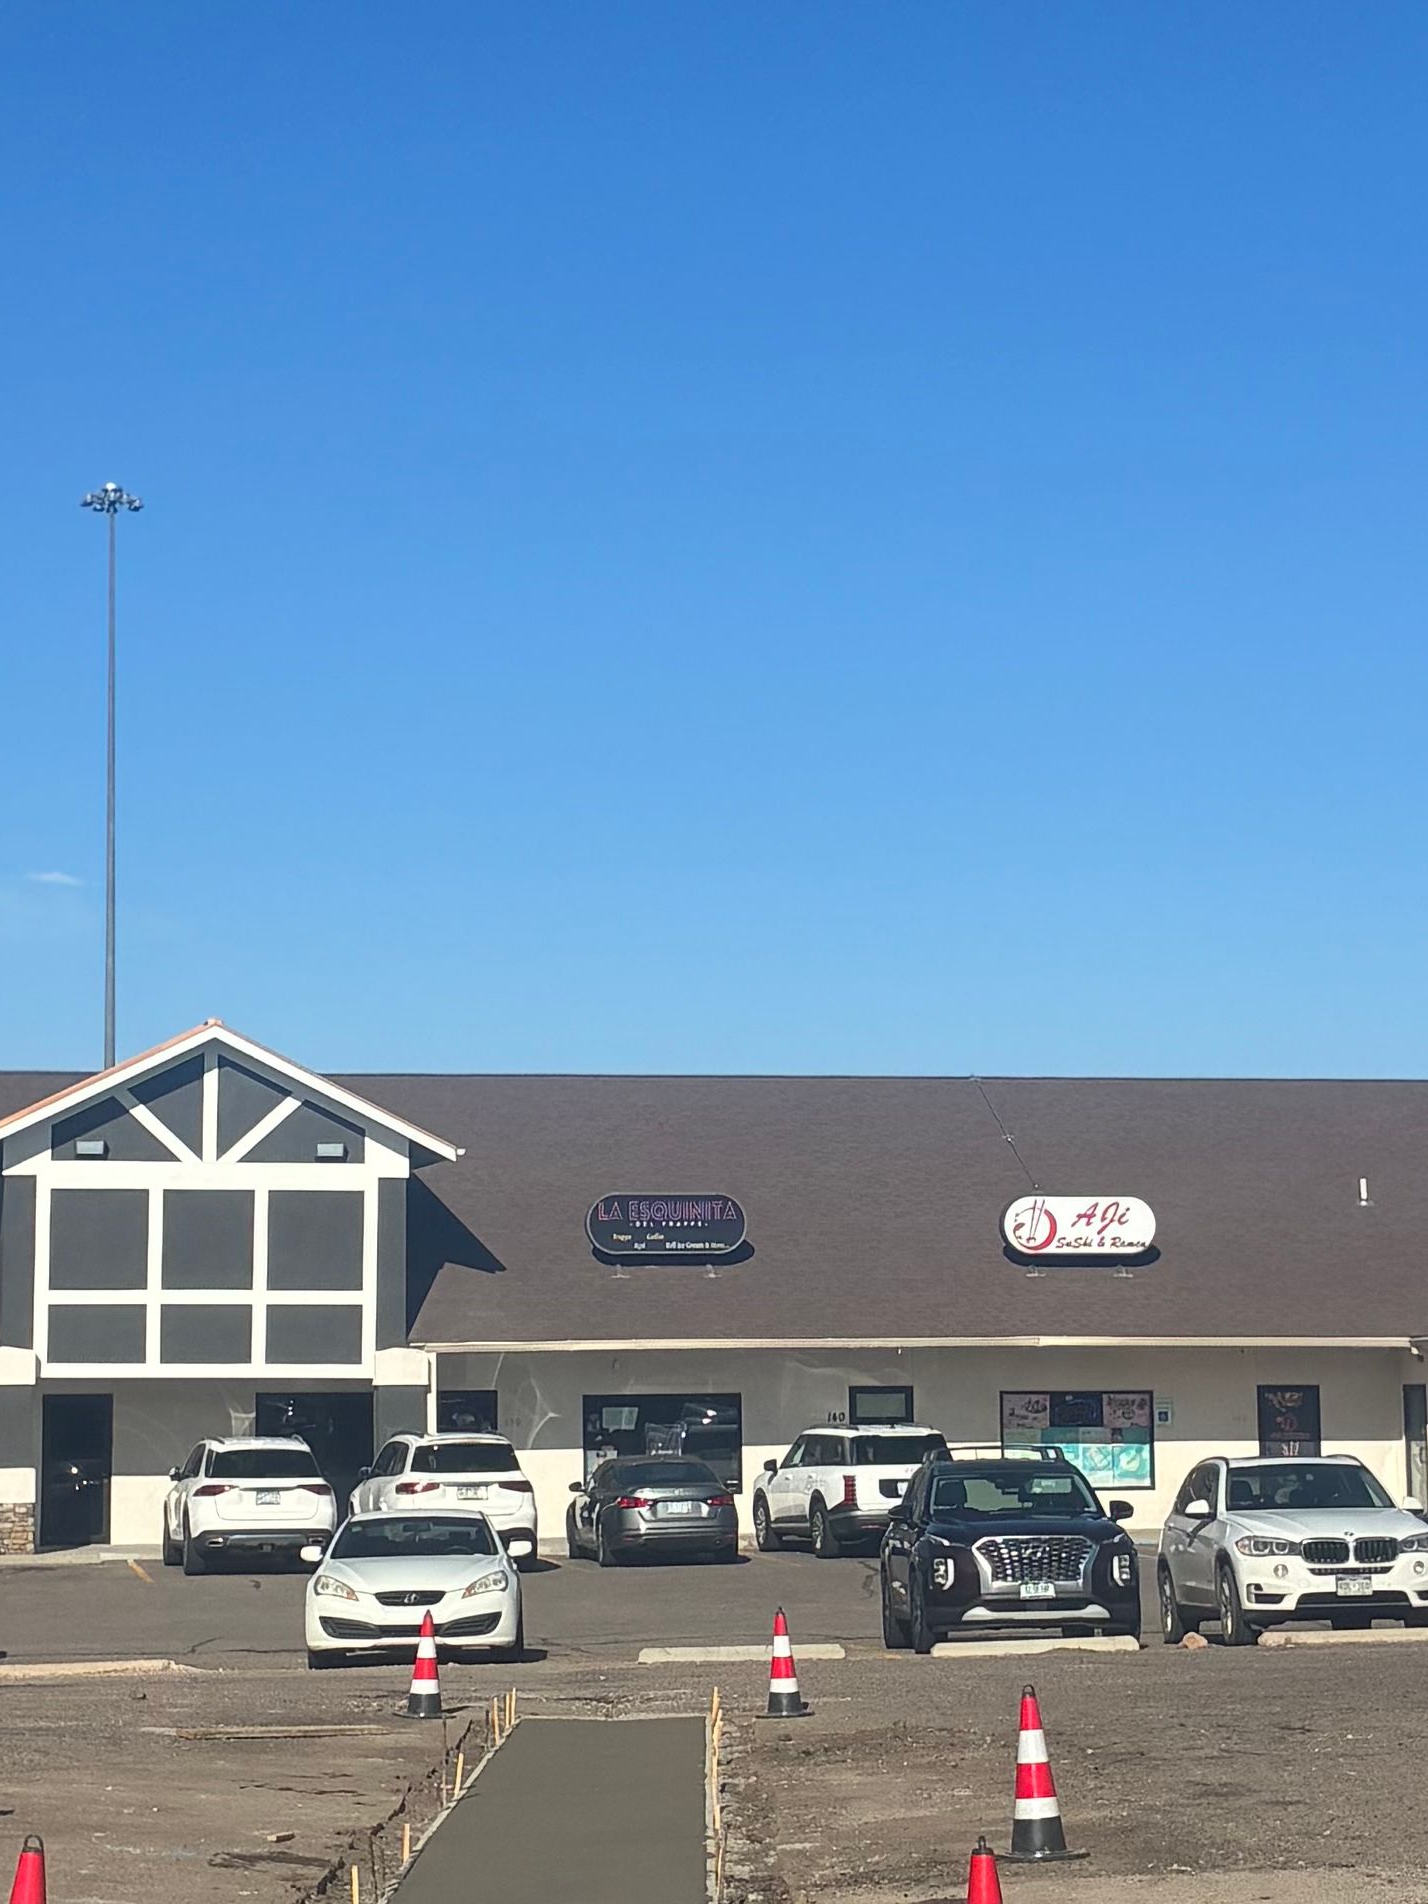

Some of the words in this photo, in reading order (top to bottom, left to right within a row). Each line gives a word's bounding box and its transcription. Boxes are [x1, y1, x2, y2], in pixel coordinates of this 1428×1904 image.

[598, 1201, 623, 1221] LA
[628, 1200, 737, 1221] ESQUINITA
[827, 1411, 846, 1423] 140
